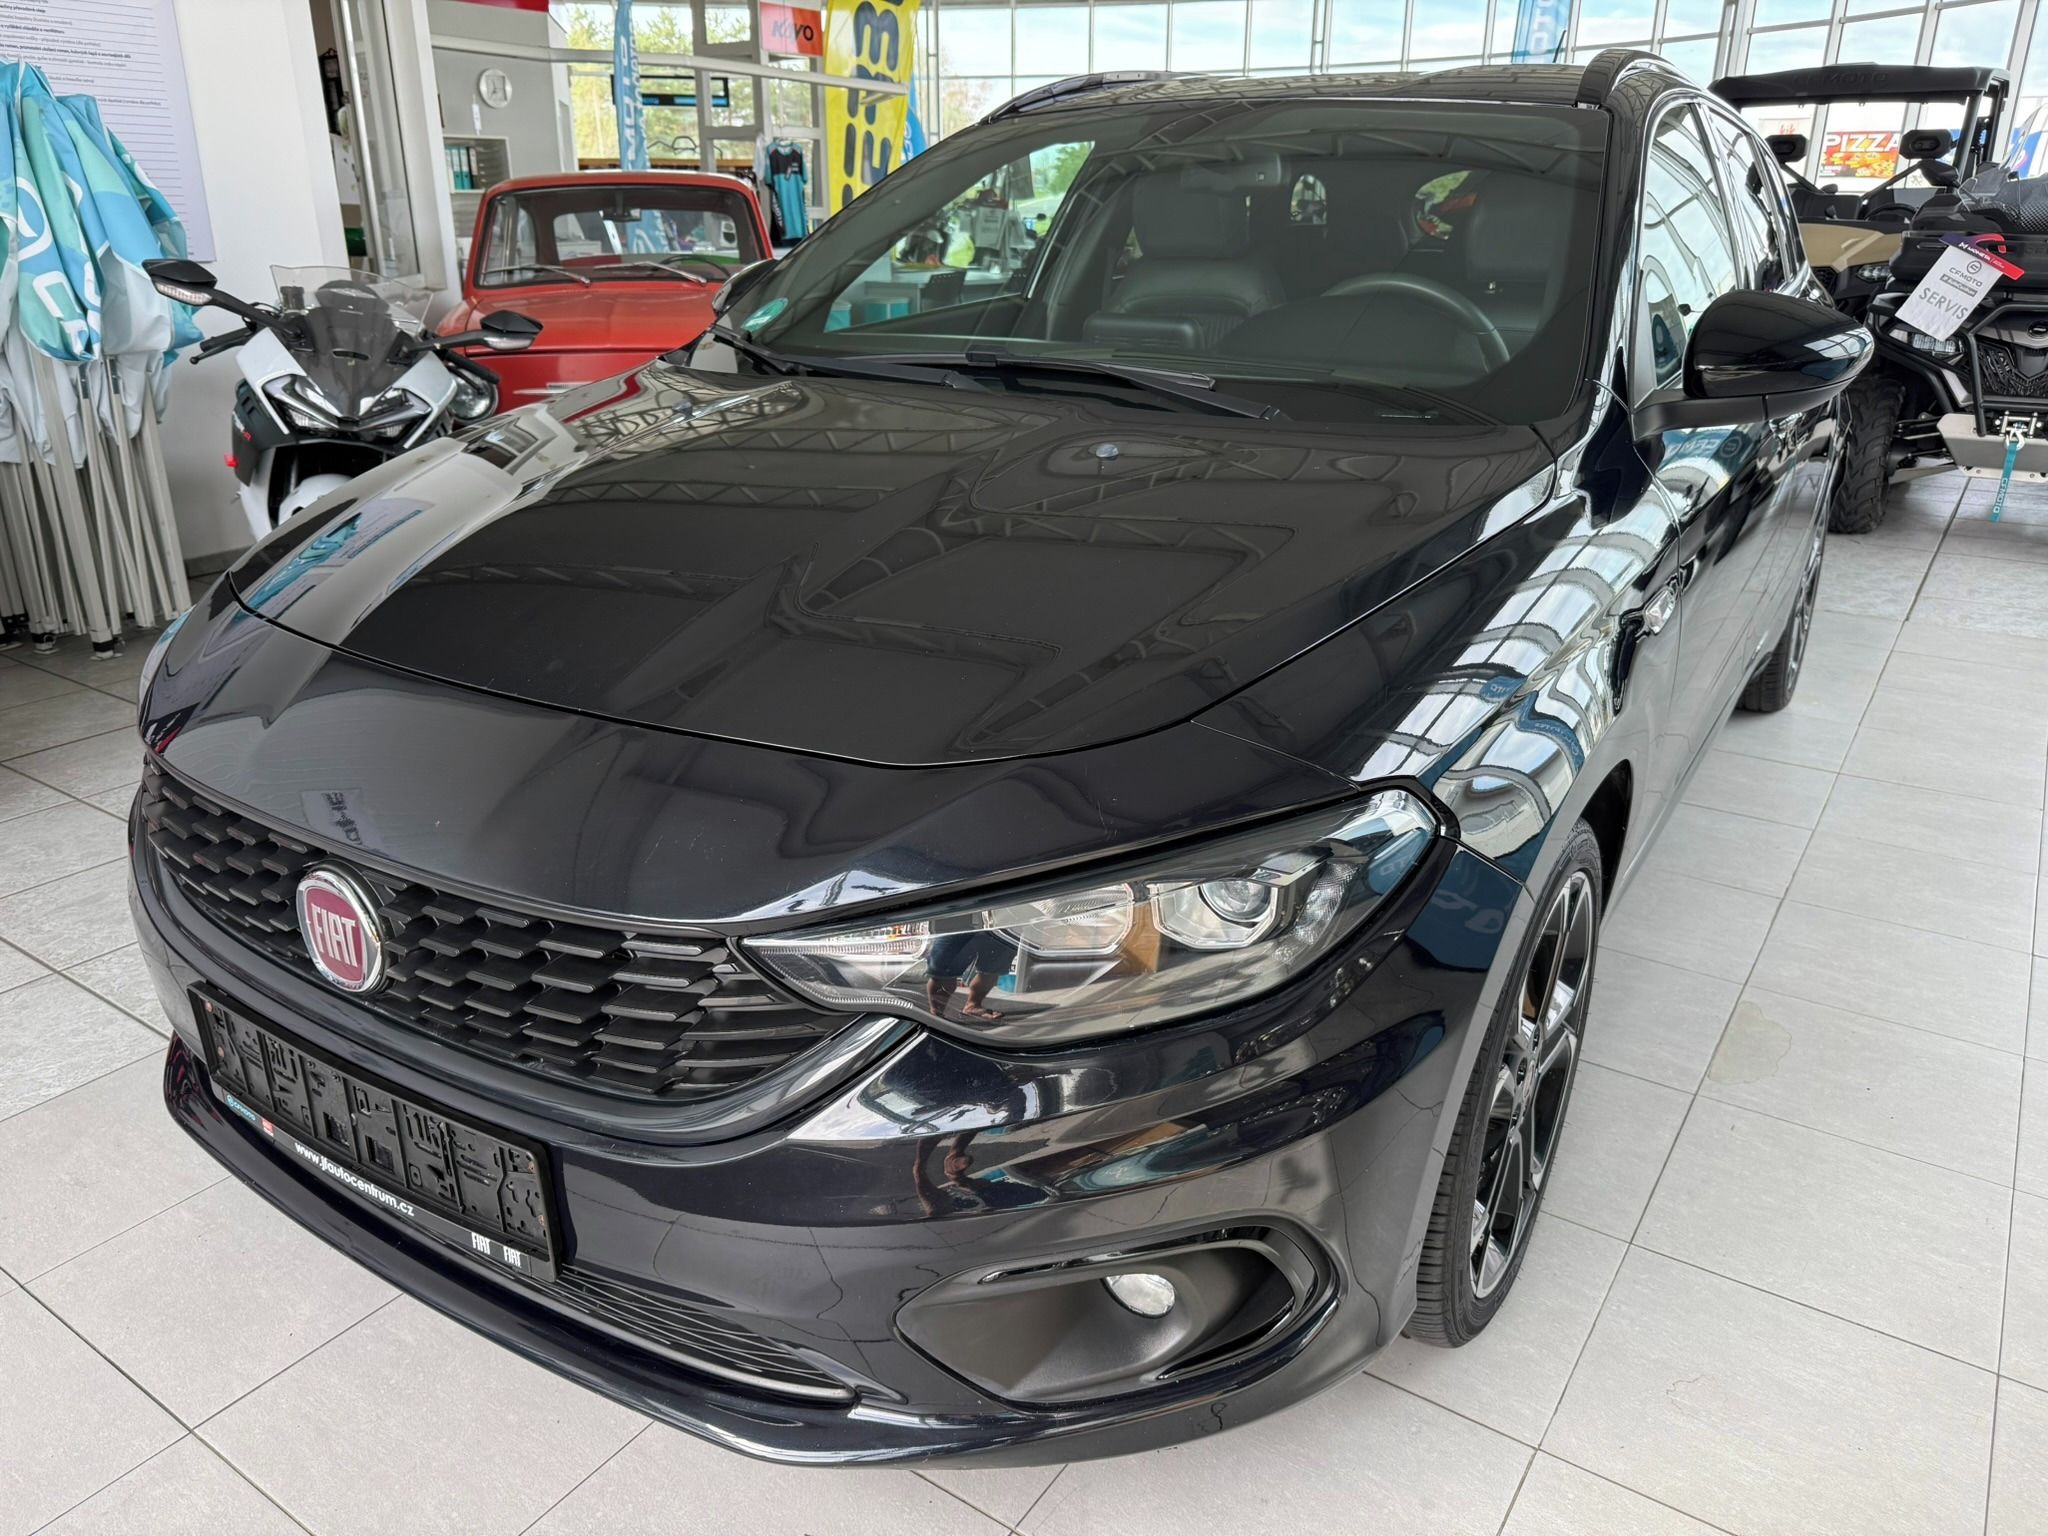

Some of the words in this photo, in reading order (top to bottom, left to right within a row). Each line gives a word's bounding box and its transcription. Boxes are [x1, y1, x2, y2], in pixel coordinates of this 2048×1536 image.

[1948, 266, 1983, 288] CFMOTO
[1918, 286, 1969, 321] SERVIS
[310, 902, 356, 968] FIAT
[293, 1141, 415, 1217] www.jfautocentrum.cz
[471, 1231, 491, 1256] FIAT
[502, 1245, 522, 1268] FIAT
